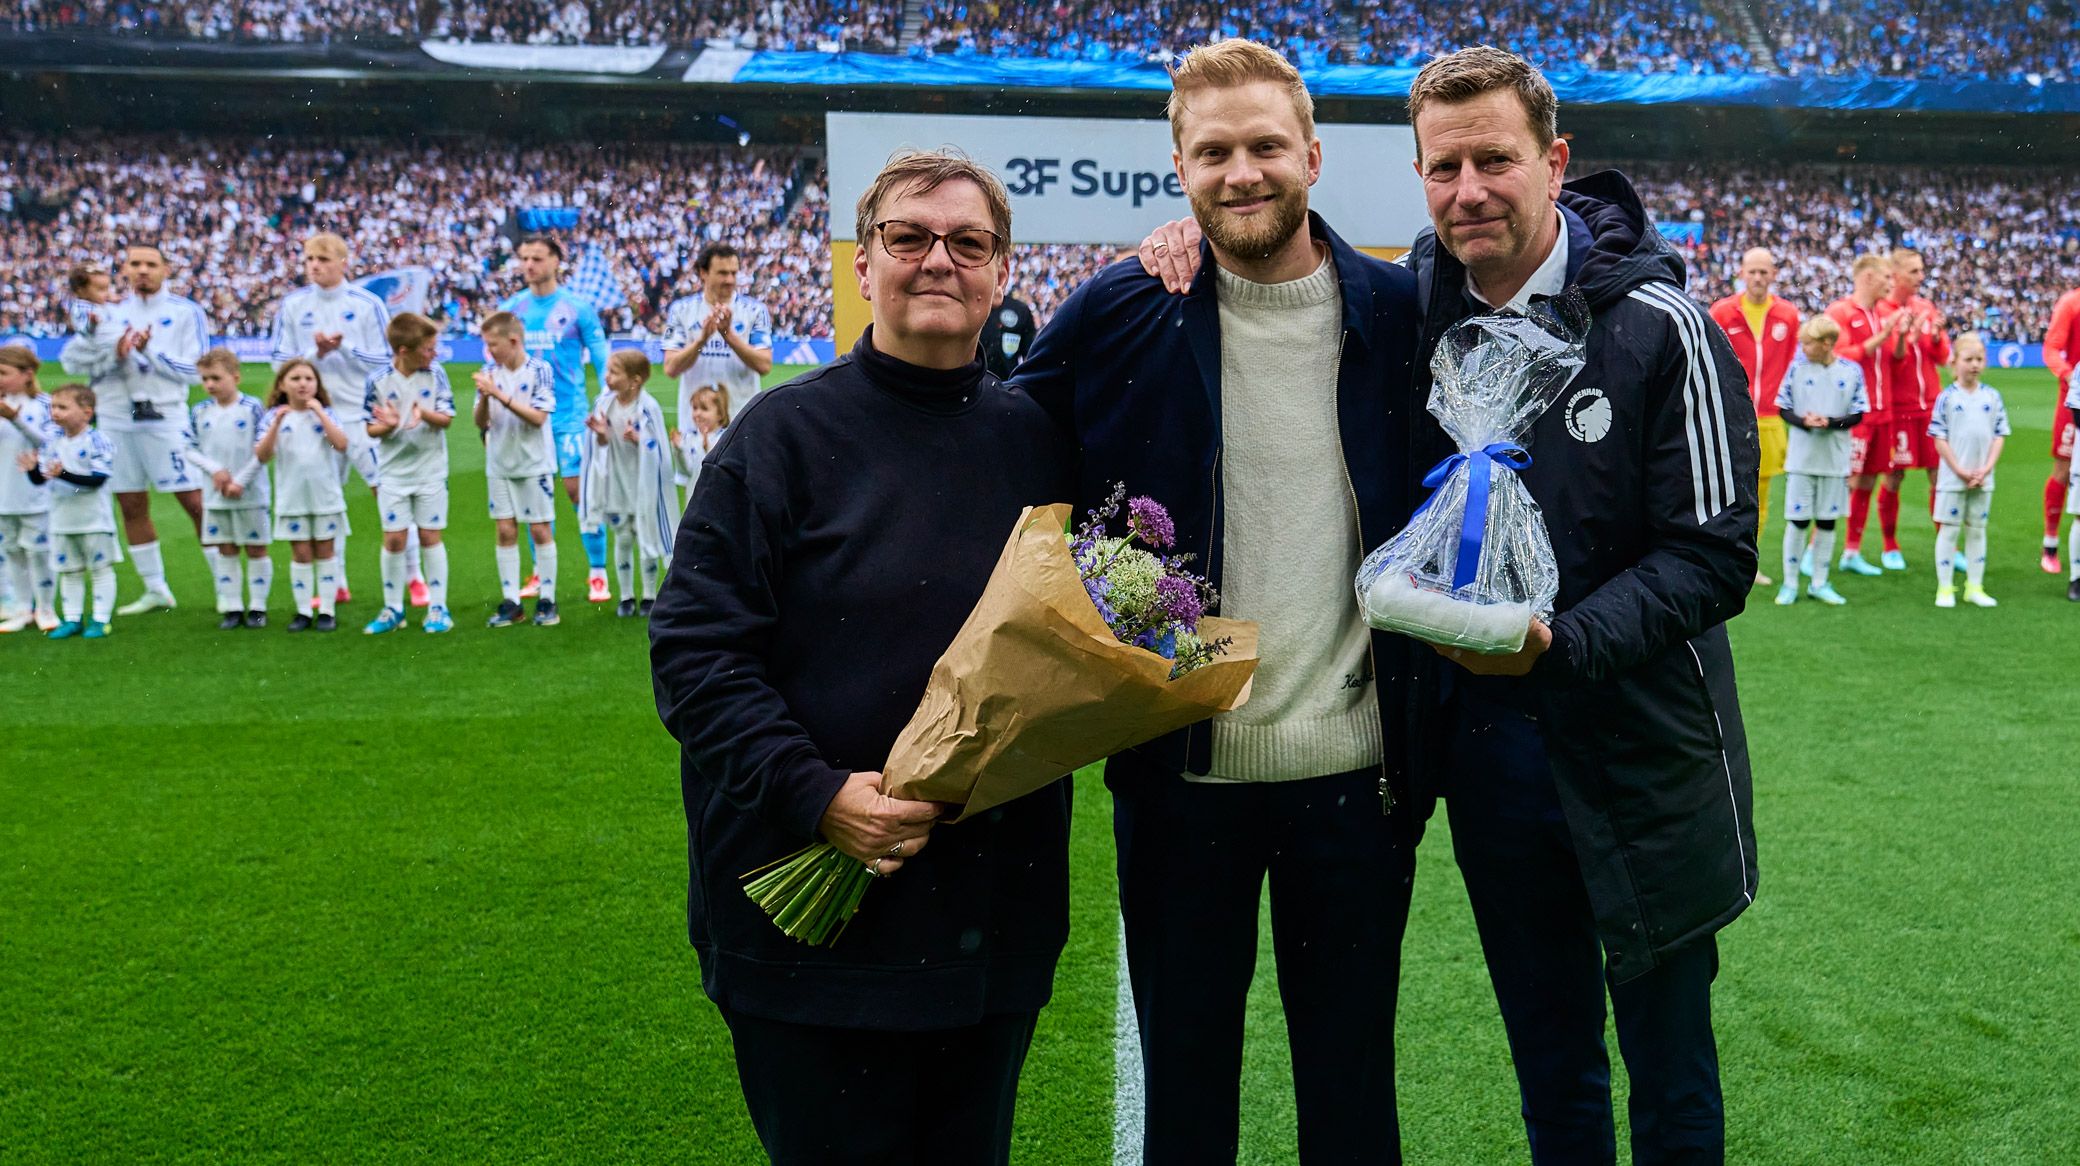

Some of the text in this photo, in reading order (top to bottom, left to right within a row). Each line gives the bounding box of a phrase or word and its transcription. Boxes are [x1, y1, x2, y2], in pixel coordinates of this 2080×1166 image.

[1005, 157, 1061, 197] 3F
[1896, 430, 1909, 452] 3
[170, 450, 185, 472] 5
